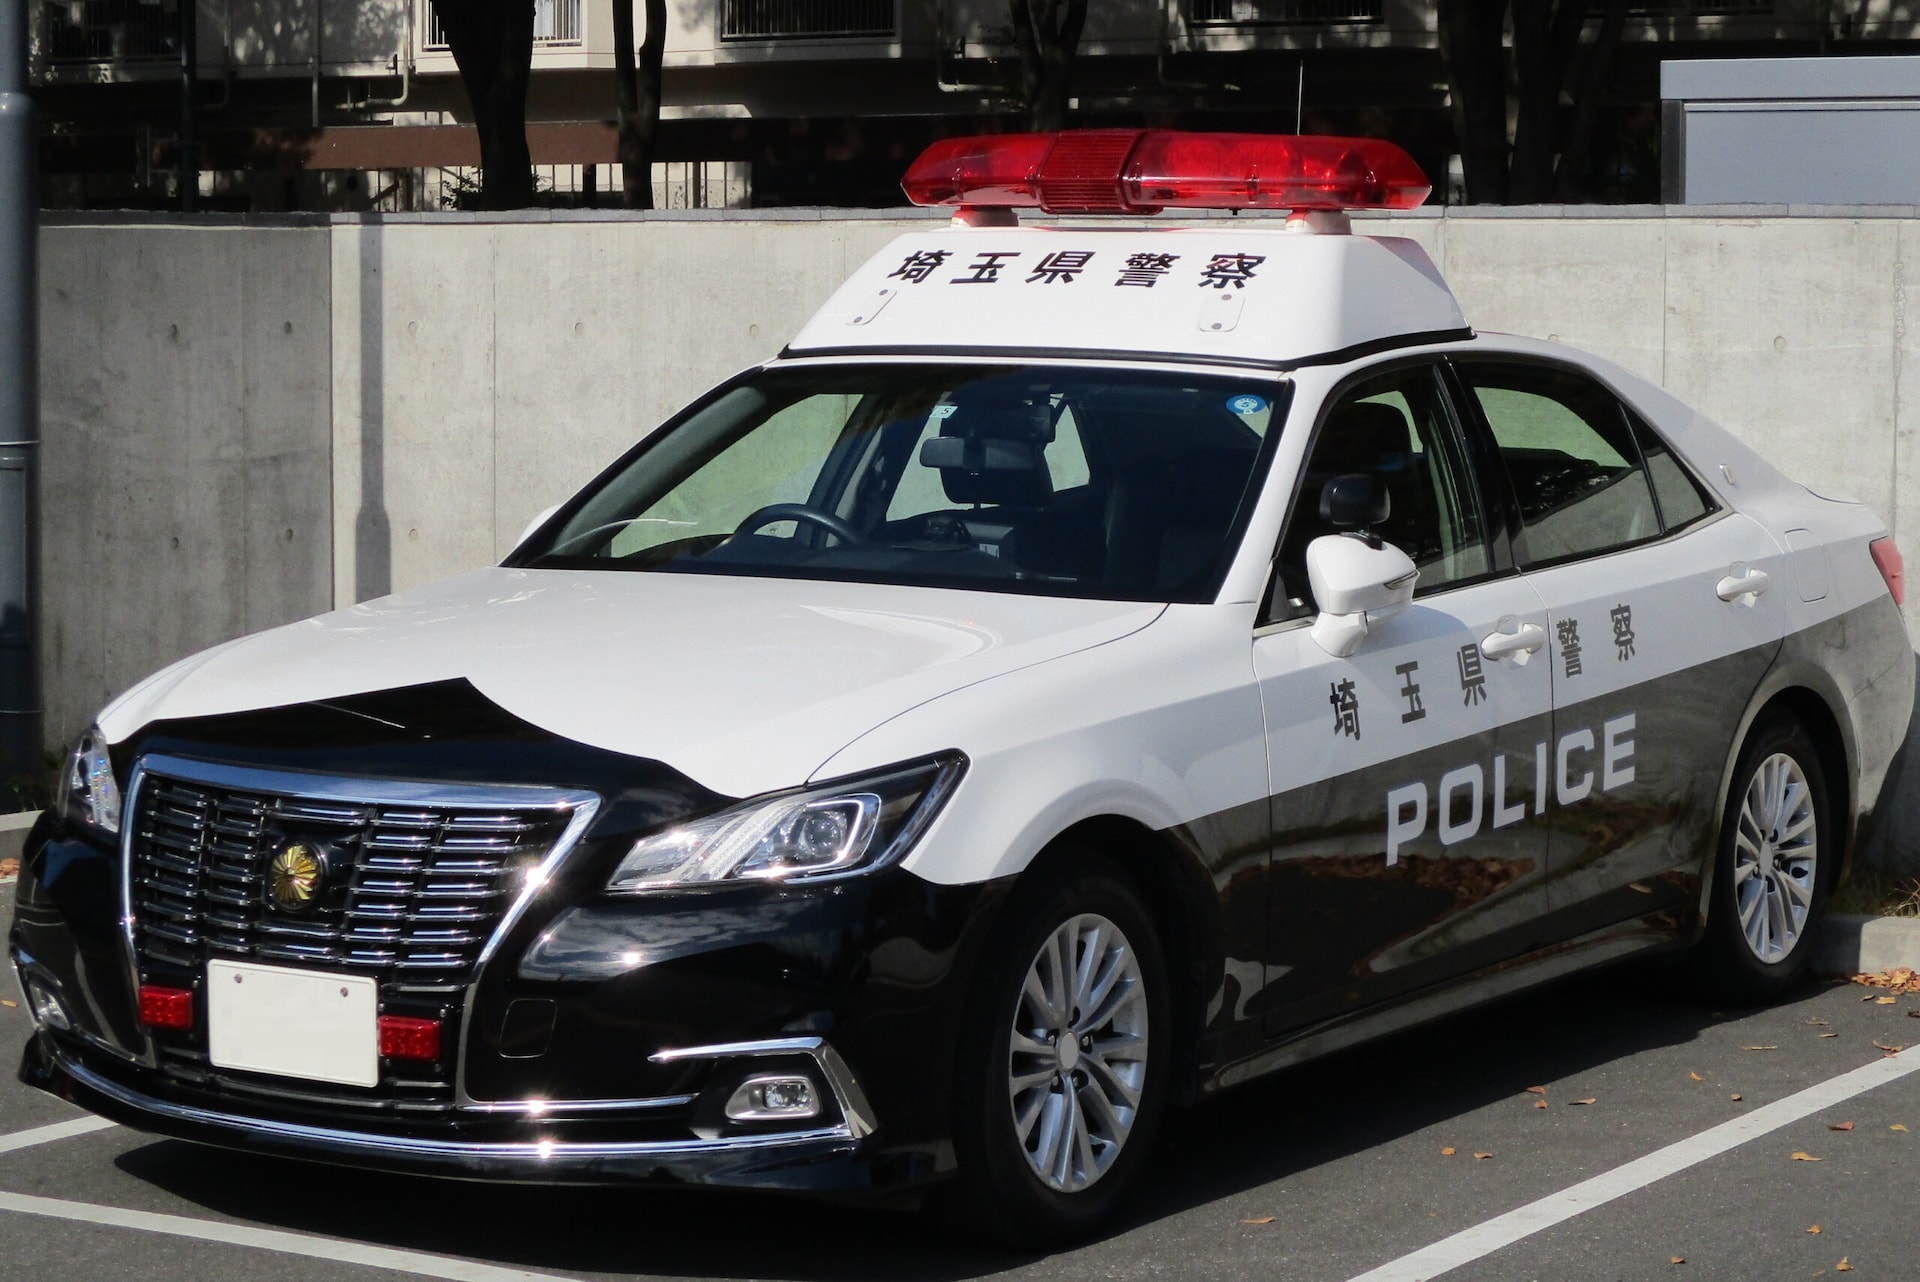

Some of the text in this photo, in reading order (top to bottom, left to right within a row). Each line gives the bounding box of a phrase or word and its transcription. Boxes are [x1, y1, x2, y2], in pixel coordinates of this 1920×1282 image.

[887, 249, 1266, 289] 埼玉県警察
[1329, 603, 1636, 741] 埼玉県警察
[1385, 712, 1637, 868] POLICE
